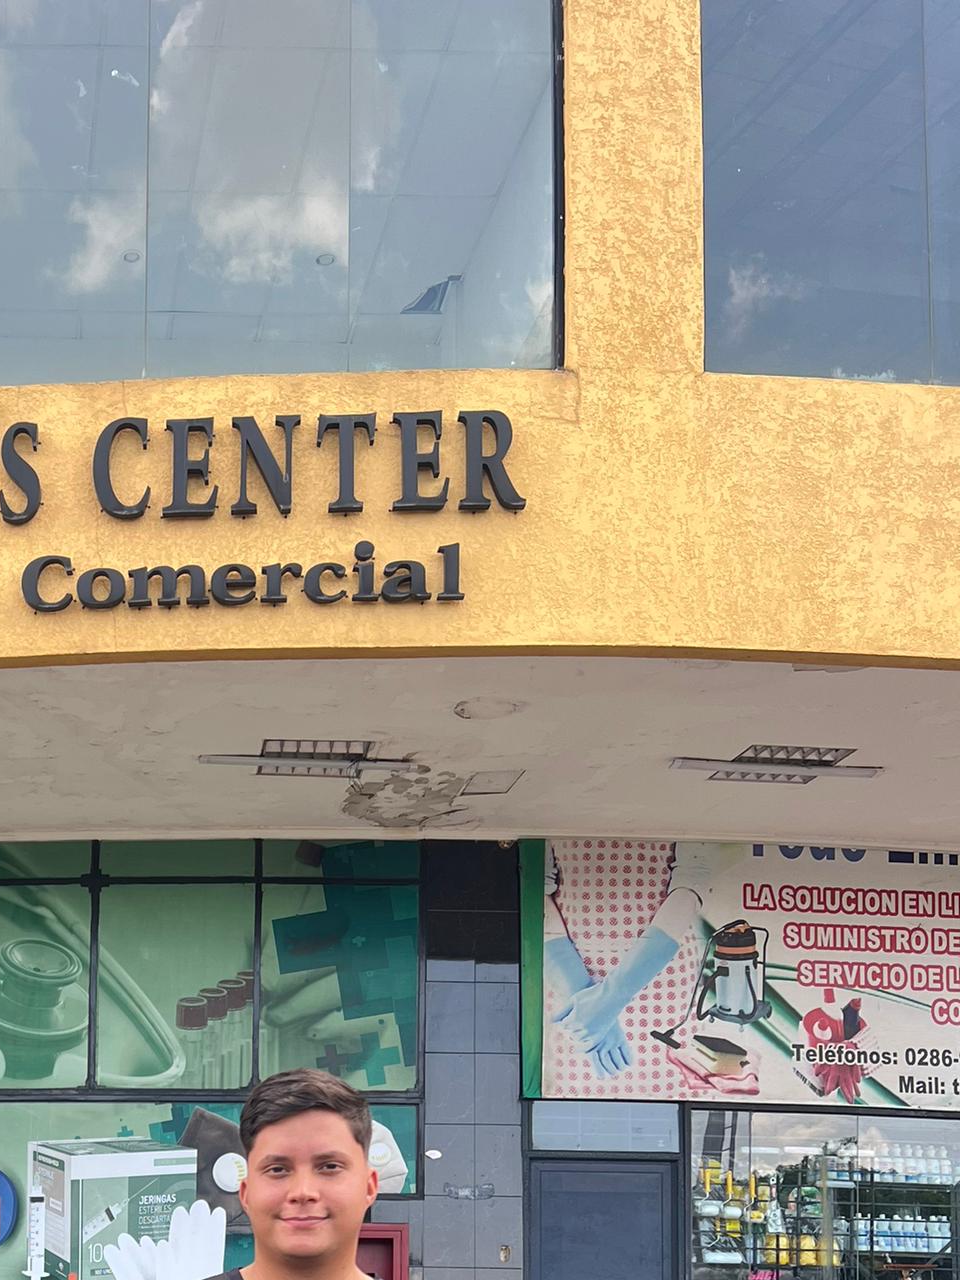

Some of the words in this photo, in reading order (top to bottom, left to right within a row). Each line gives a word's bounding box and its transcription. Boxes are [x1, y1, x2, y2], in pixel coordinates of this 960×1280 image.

[92, 409, 527, 522] CENTER
[20, 539, 466, 614] Comercial
[743, 884, 776, 910] LA
[779, 886, 898, 916] SOLUCION
[902, 890, 936, 917] EN
[797, 959, 907, 990] SERVICIO
[911, 964, 944, 991] DE
[791, 1043, 898, 1065] Teléfonos:
[904, 1047, 960, 1068] 0286-
[898, 1075, 946, 1095] Mail:
[139, 1194, 177, 1205] JERINGAS
